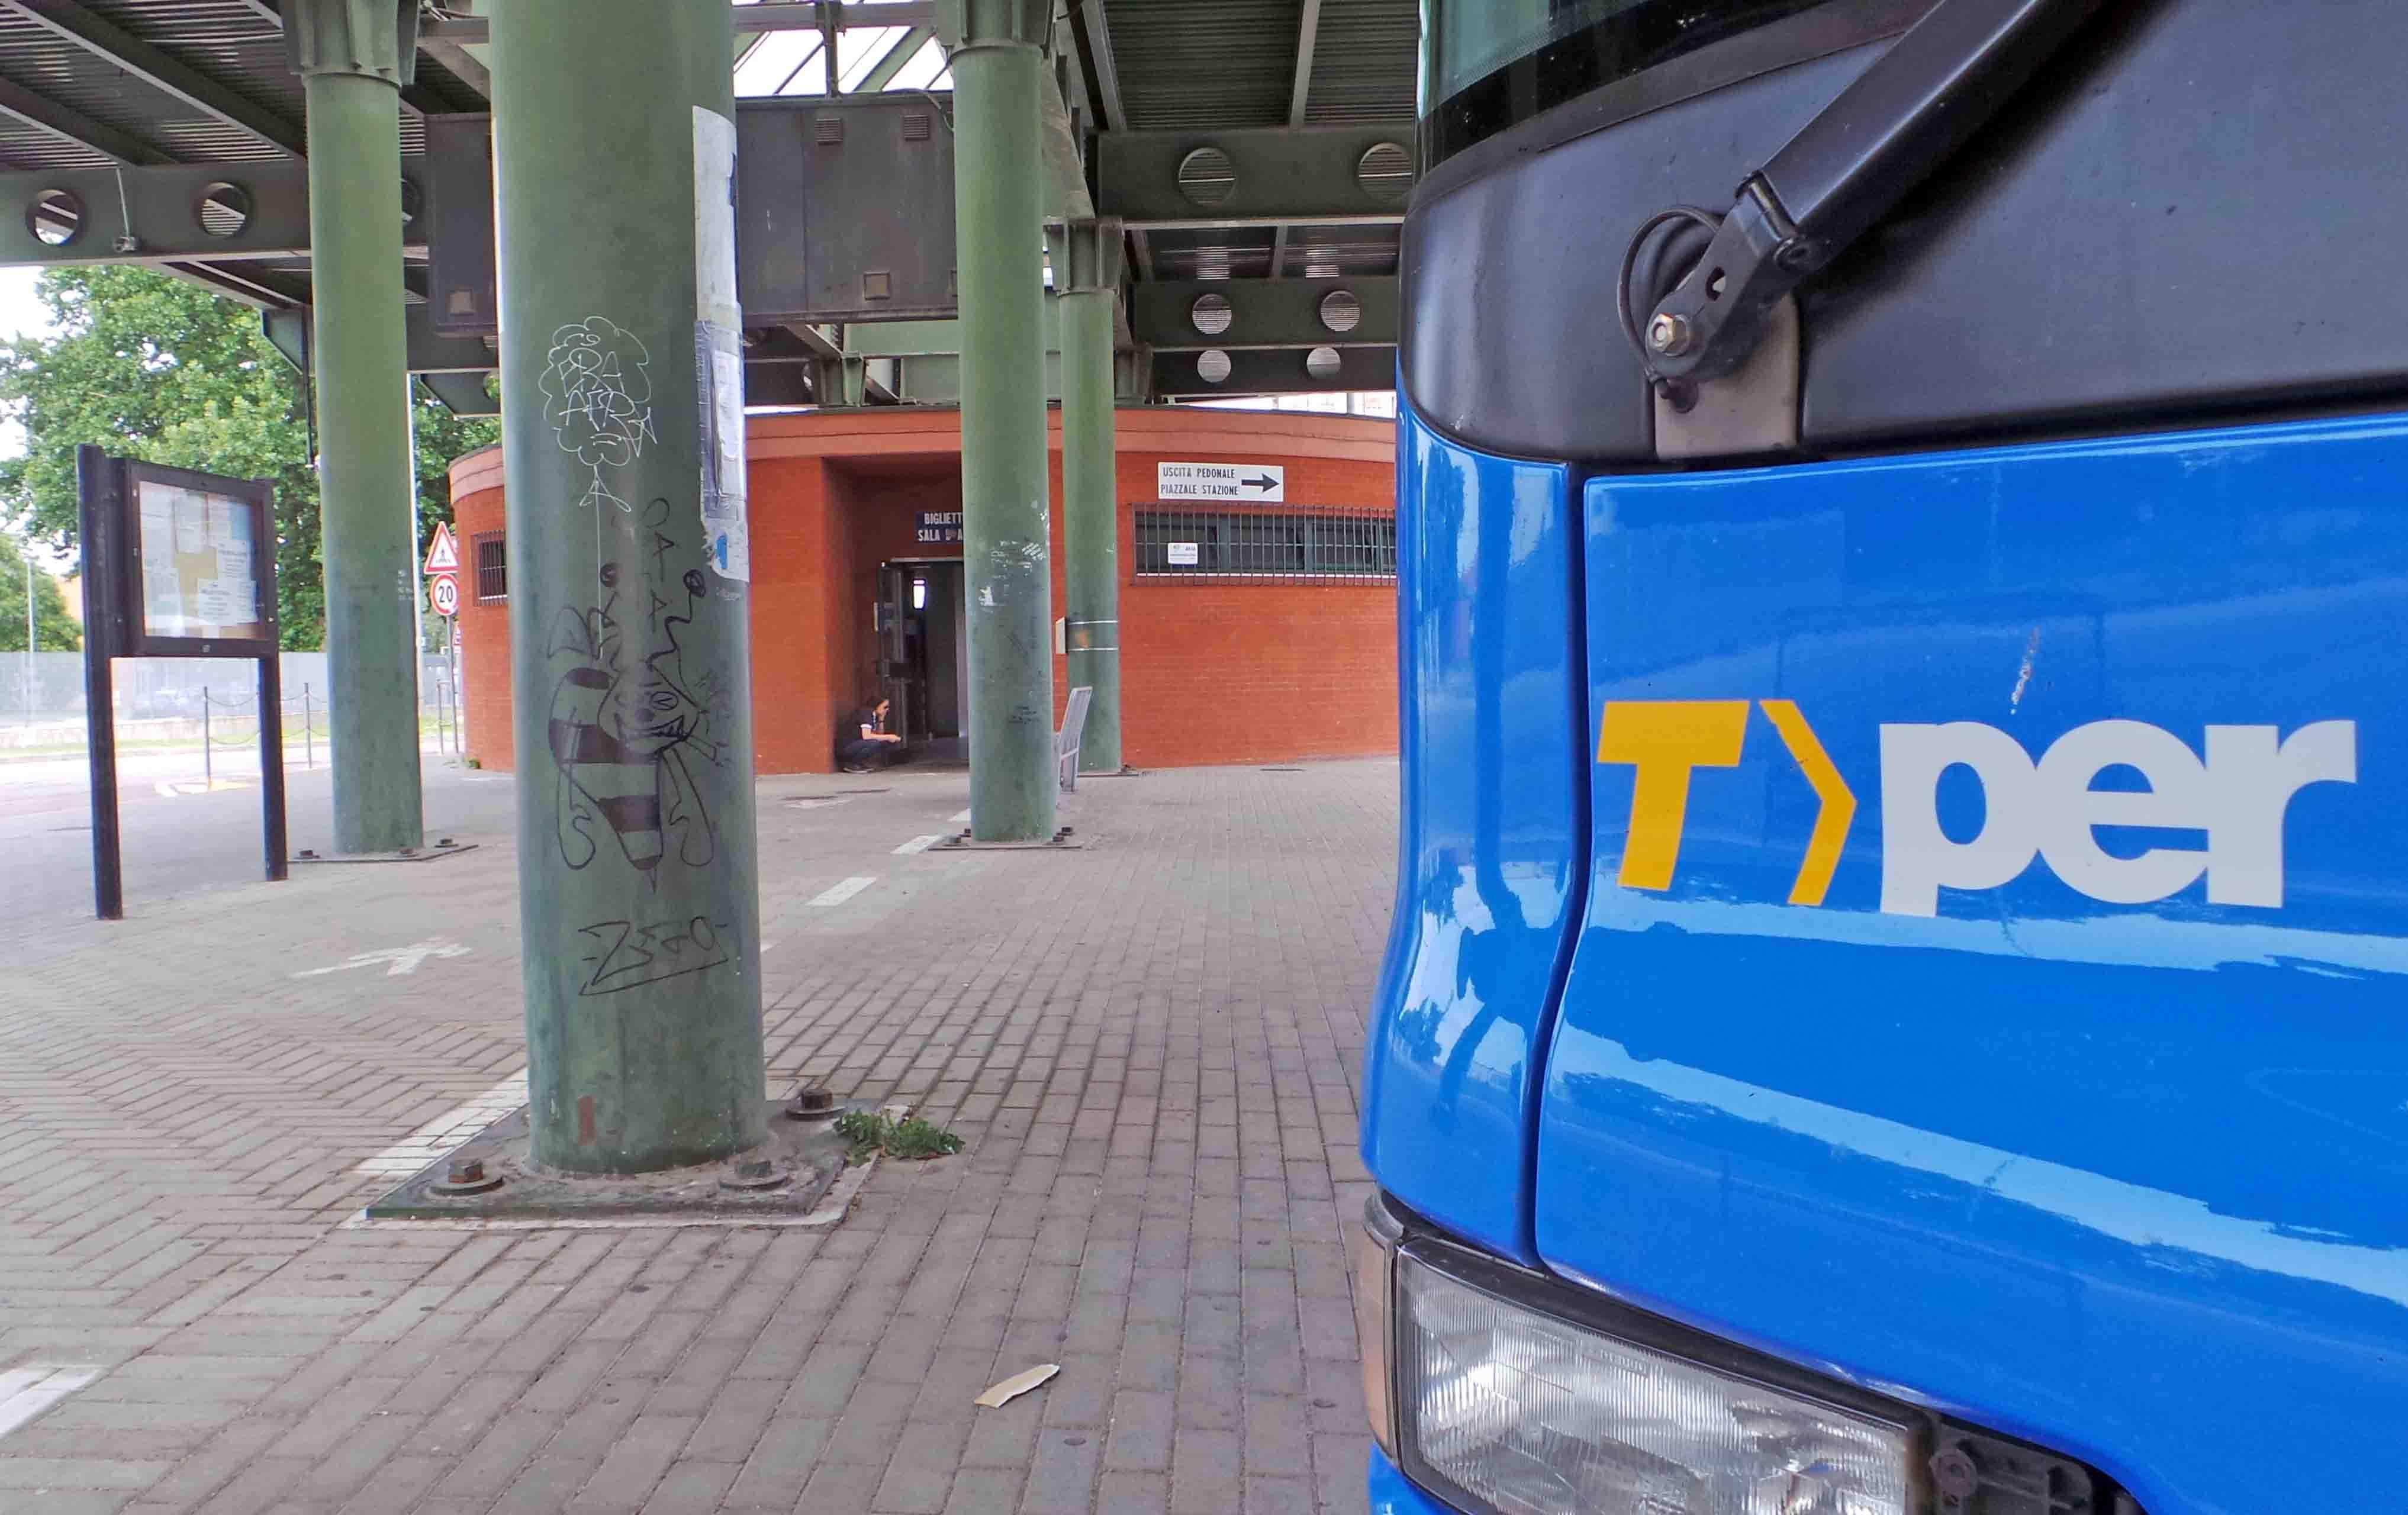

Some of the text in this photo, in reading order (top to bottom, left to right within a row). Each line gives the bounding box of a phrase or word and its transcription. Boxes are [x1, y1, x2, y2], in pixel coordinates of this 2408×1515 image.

[1163, 466, 1235, 479] USCITA PEDONALE
[1161, 483, 1238, 495] PIAZZALE STAZIONE
[918, 530, 941, 541] SALA
[438, 585, 453, 603] 20
